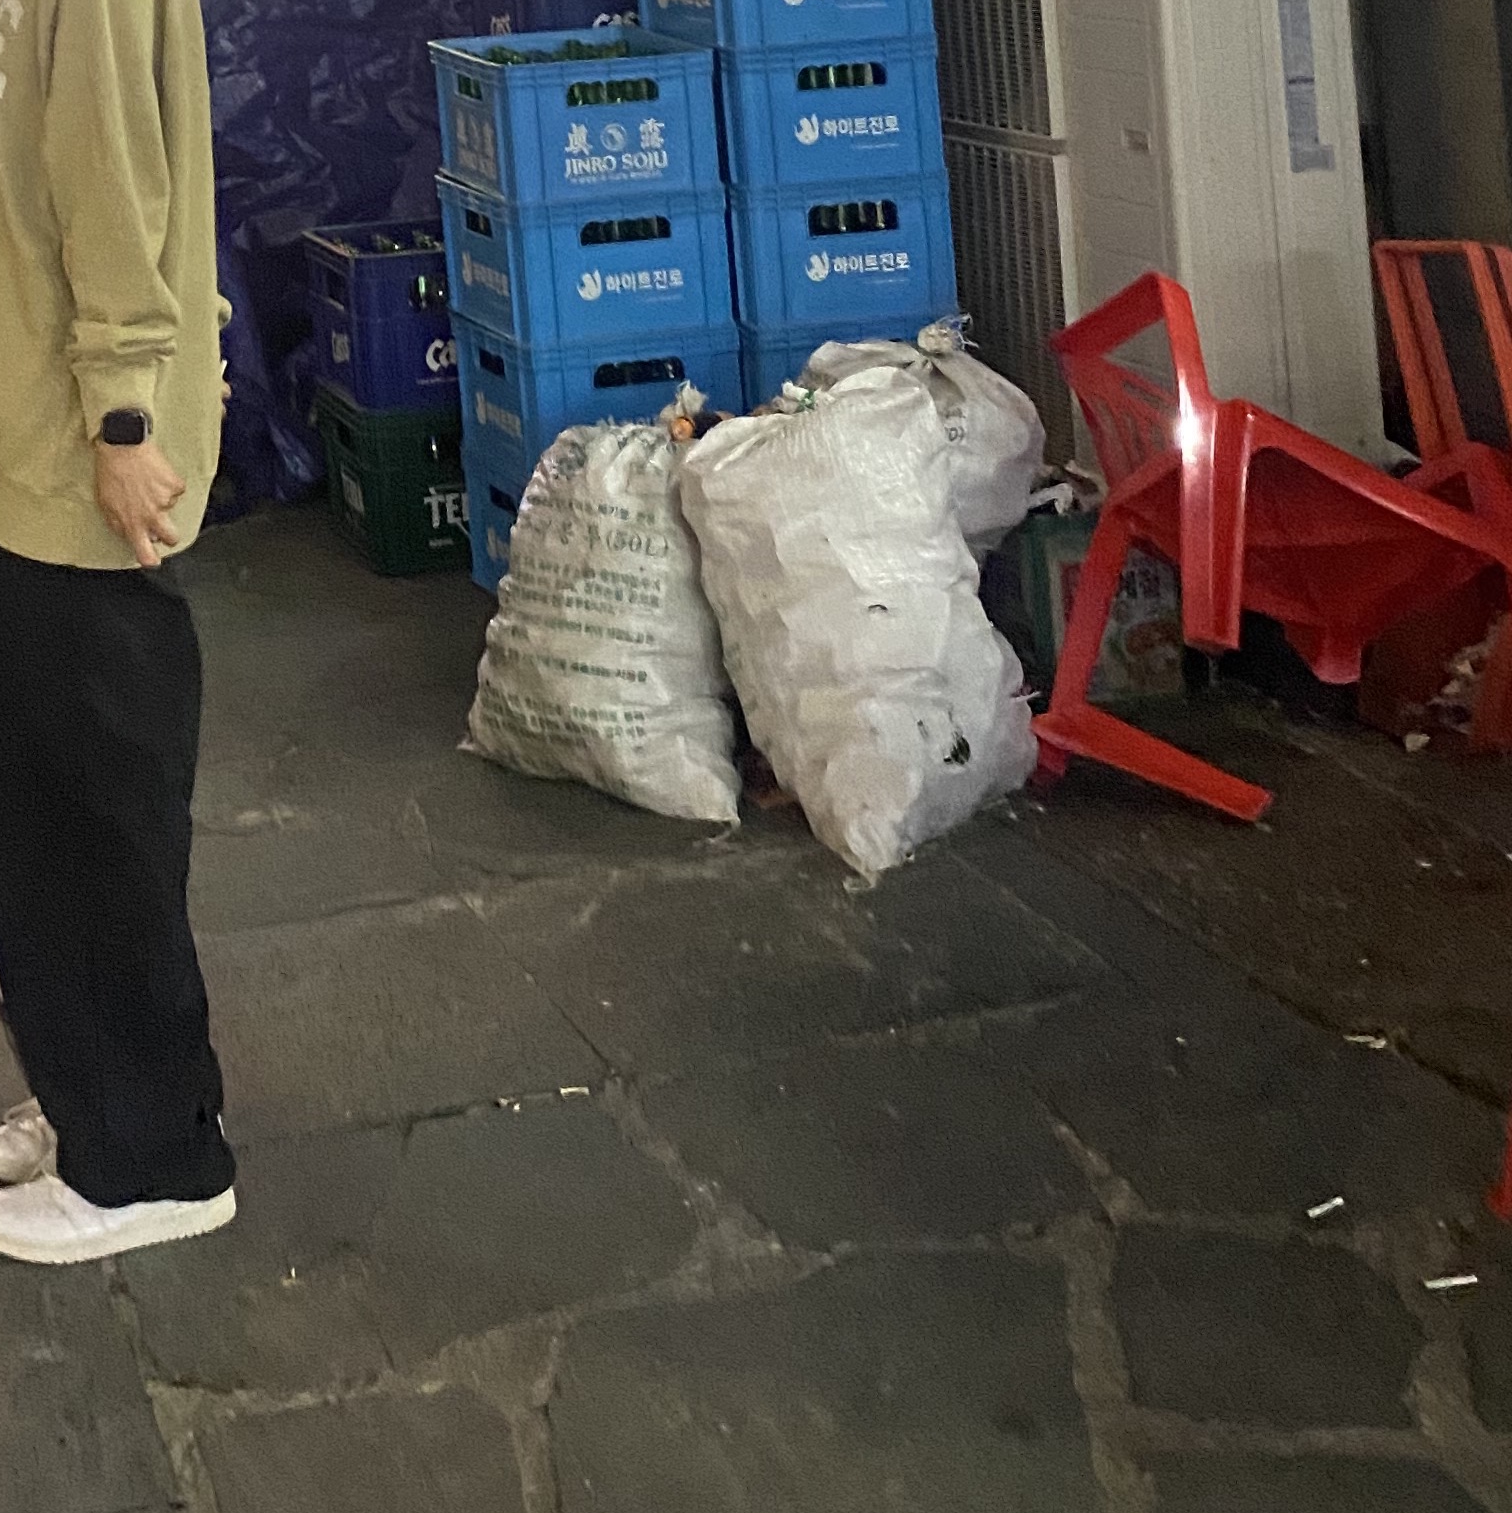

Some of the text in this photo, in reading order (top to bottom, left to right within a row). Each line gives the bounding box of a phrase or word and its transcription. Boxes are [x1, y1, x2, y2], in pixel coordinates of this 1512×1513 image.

[822, 115, 900, 138] 하이트진로
[564, 154, 617, 178] JINRO
[621, 150, 668, 170] SOJU
[832, 253, 911, 275] 하이트진로
[605, 268, 684, 294] 하이트진로
